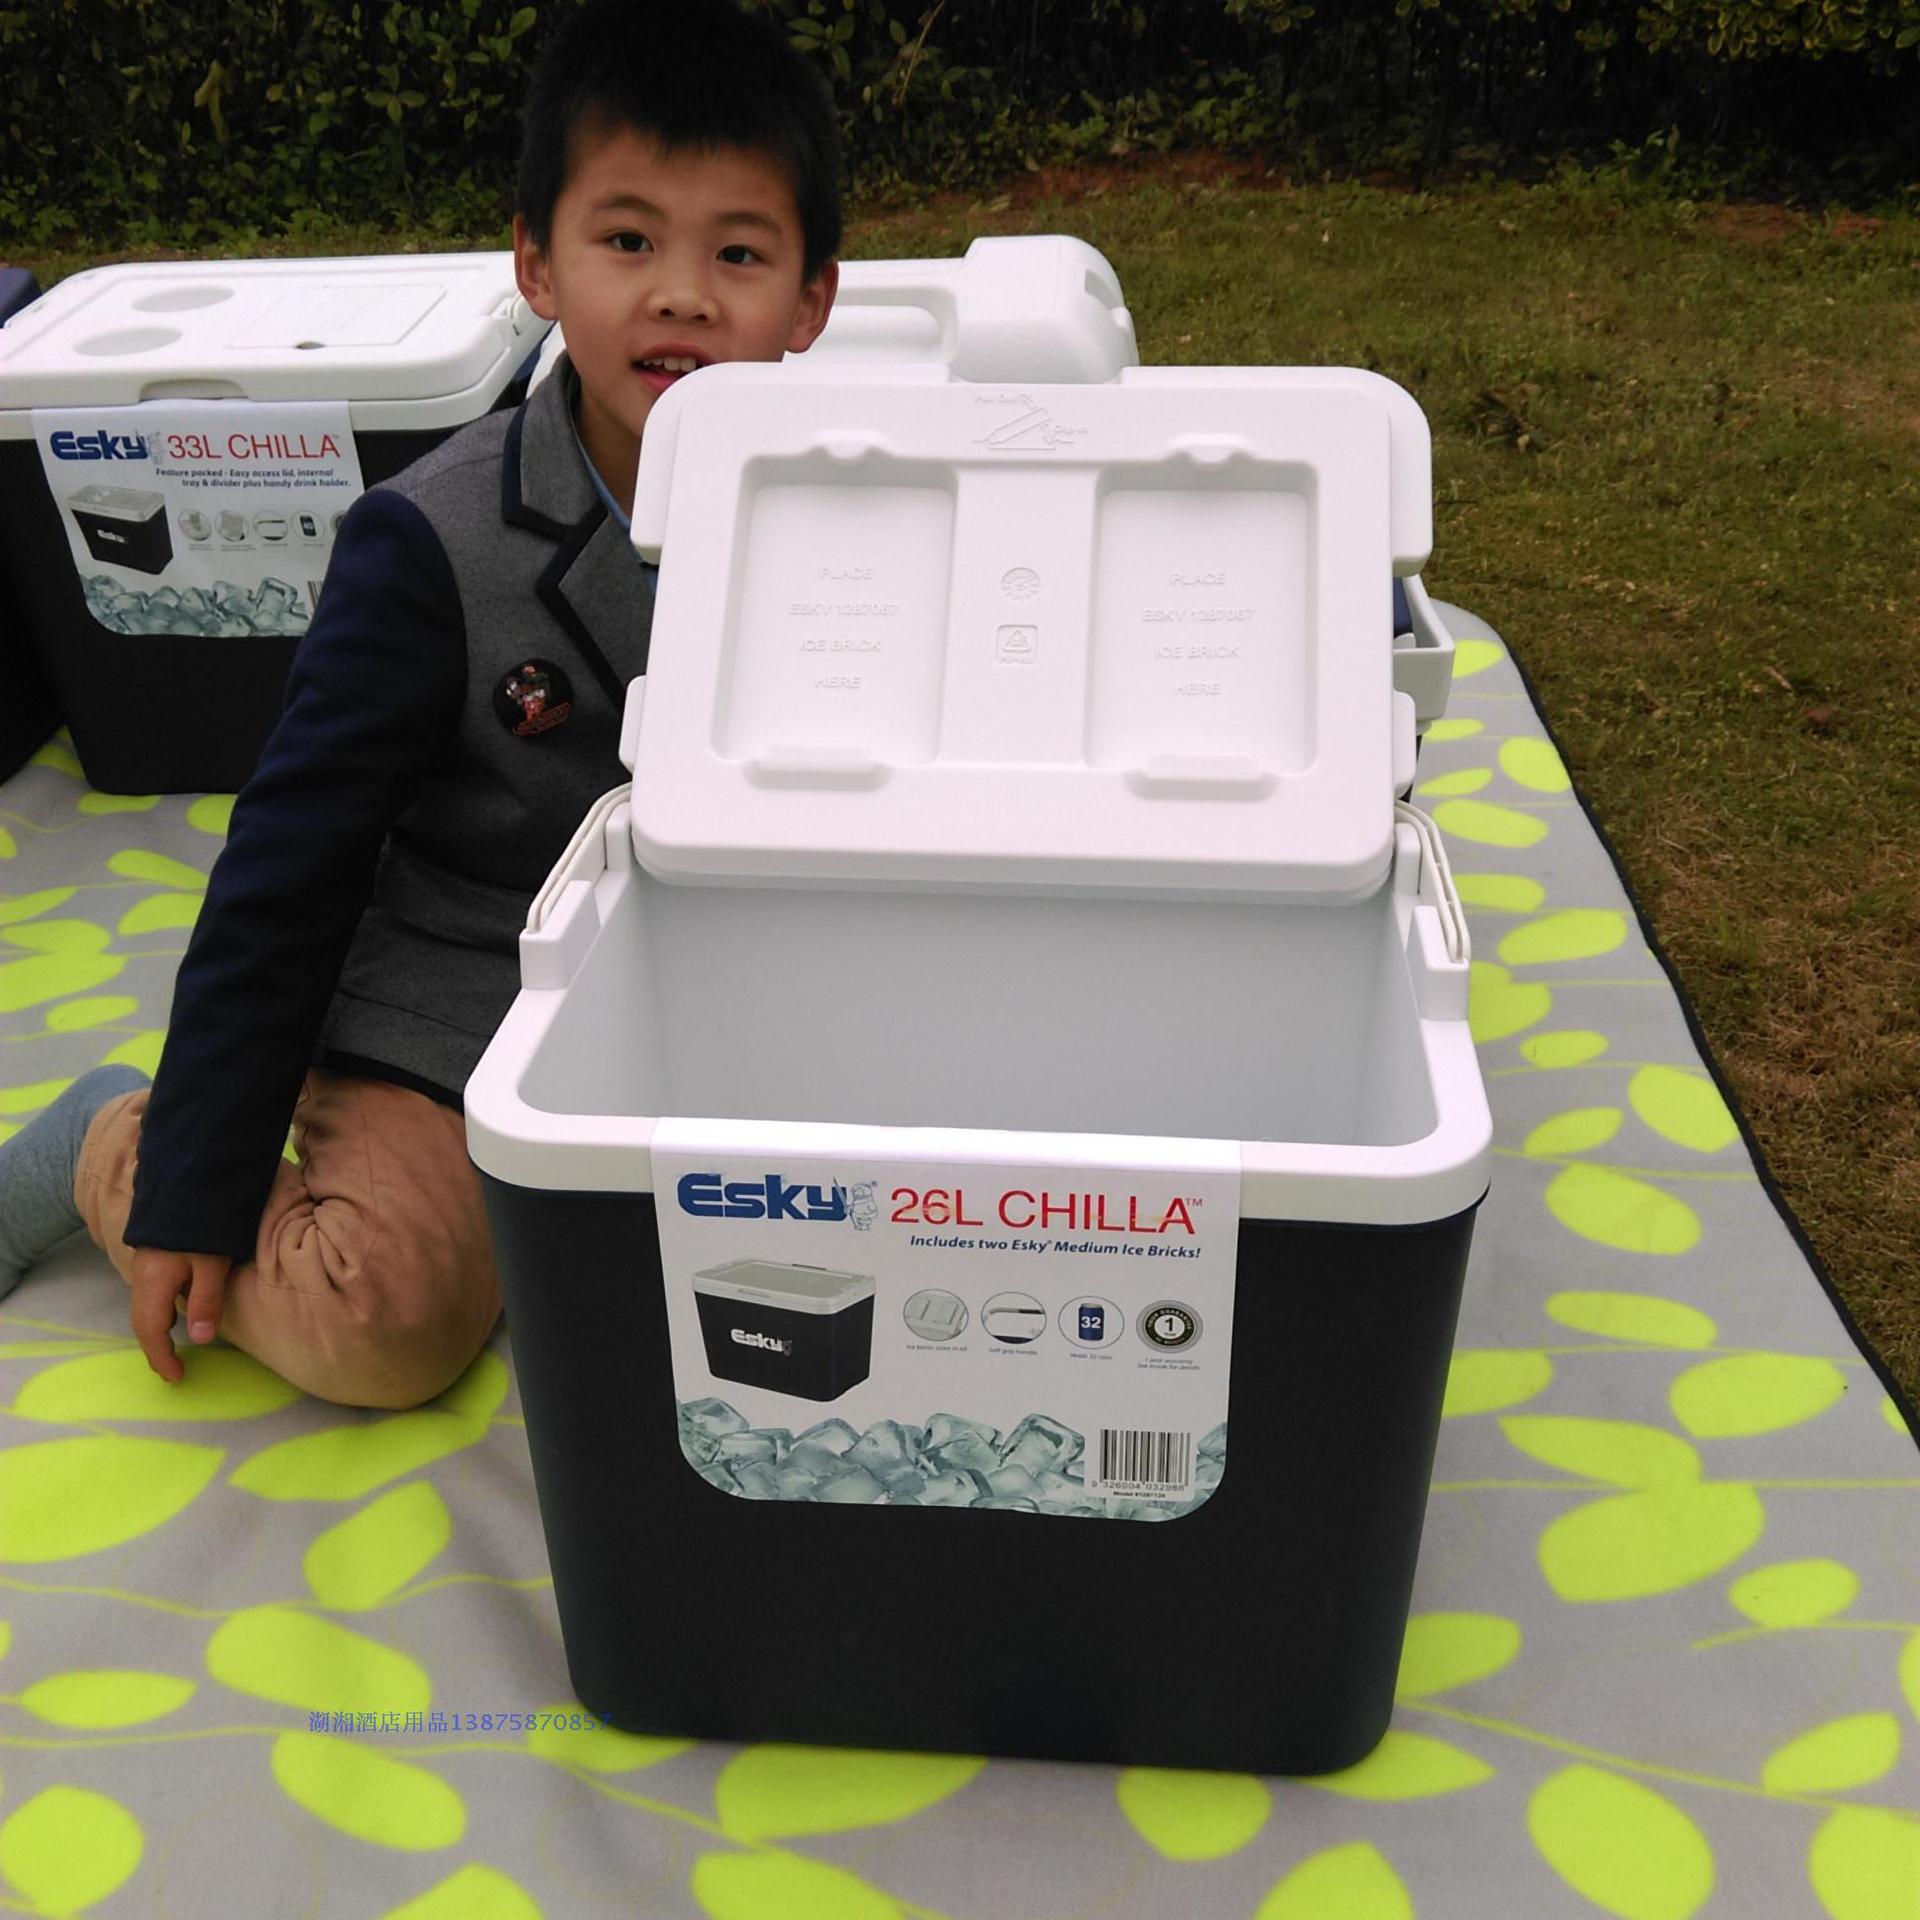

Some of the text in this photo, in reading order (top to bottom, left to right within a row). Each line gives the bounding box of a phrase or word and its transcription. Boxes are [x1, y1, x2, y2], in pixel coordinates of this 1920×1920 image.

[51, 430, 149, 460] Esky
[167, 434, 222, 459] 33L
[155, 468, 189, 477] Feature
[191, 468, 223, 479] packed
[229, 469, 250, 479] Easy
[297, 469, 333, 477] internal
[182, 479, 200, 488] tray
[202, 479, 209, 487] &
[210, 479, 242, 488] divider
[243, 479, 261, 489] plus
[263, 479, 292, 489] handy
[293, 479, 317, 488] drink
[818, 567, 873, 580] PLACE
[1169, 572, 1228, 586] PLACE
[789, 602, 833, 616] ESKY
[1141, 608, 1187, 622] ESKY
[799, 639, 882, 652] ICE BRICK
[1154, 645, 1241, 659] ICE BRICK
[815, 675, 861, 689] HERE
[1172, 681, 1223, 695] HERE
[677, 1173, 848, 1221] Esky
[891, 1188, 983, 1226] 26L
[910, 1235, 975, 1249] Includes
[978, 1239, 1008, 1250] two
[1054, 1241, 1119, 1255] Medium
[1122, 1244, 1145, 1256] Ice
[1147, 1245, 1201, 1259] Bricks!
[1081, 1316, 1101, 1329] 32
[1164, 1317, 1174, 1332] 1
[731, 1329, 783, 1352] Esky
